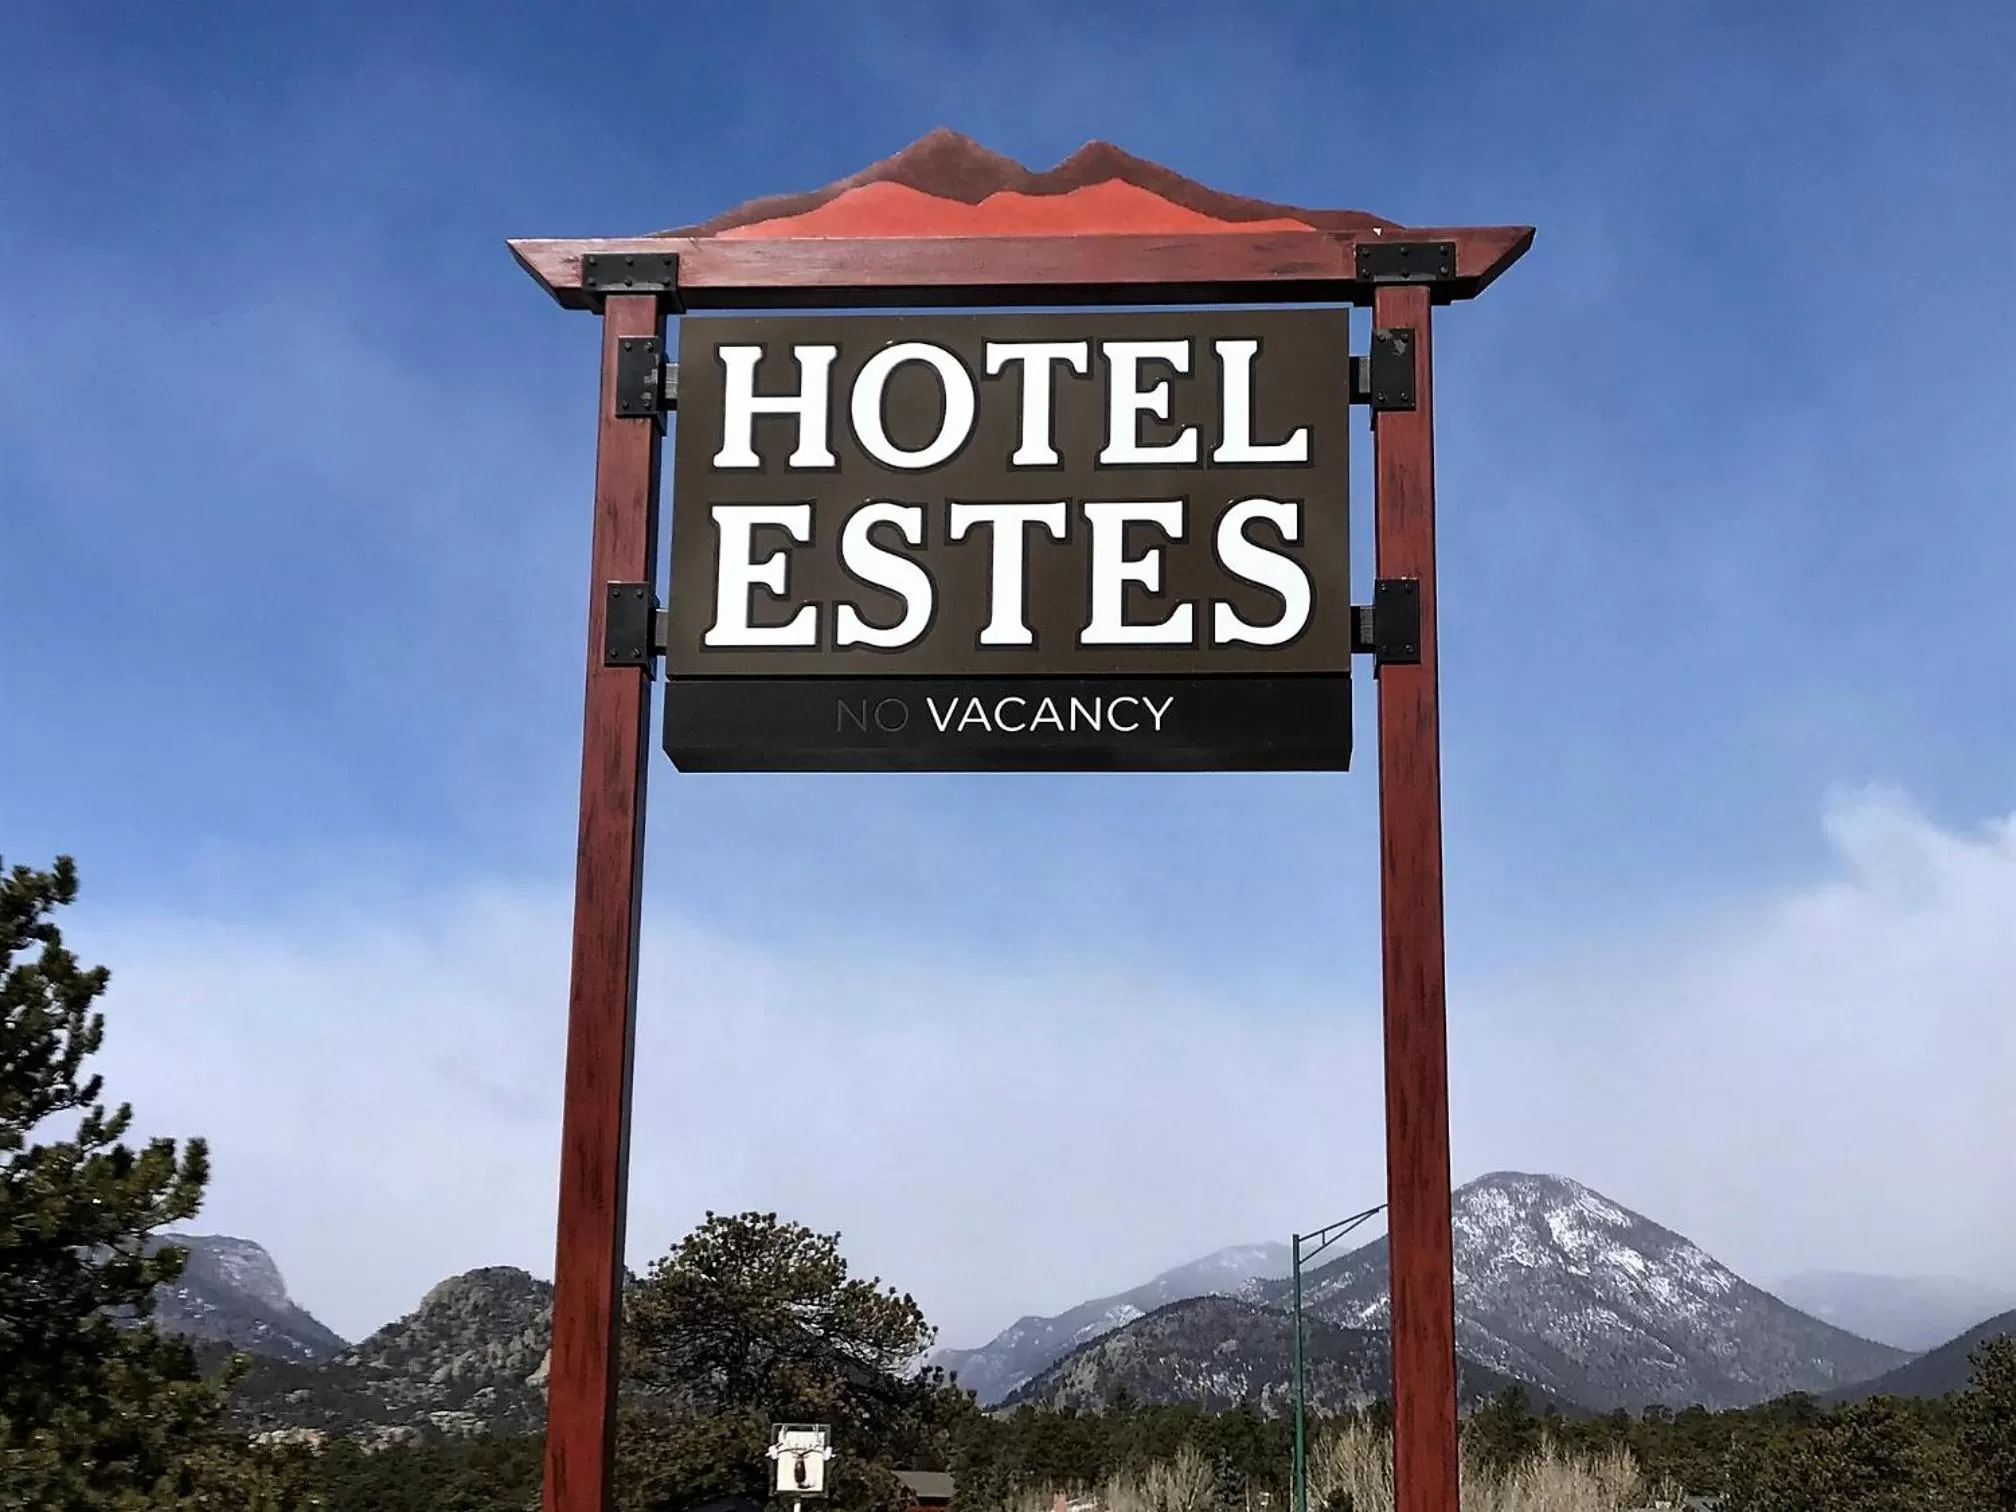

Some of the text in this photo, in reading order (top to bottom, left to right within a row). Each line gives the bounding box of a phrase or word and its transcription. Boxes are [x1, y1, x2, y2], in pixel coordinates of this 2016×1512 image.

[712, 339, 1309, 468] HOTEL
[703, 498, 1312, 647] ESTES
[836, 696, 1174, 732] NO VACANCY
